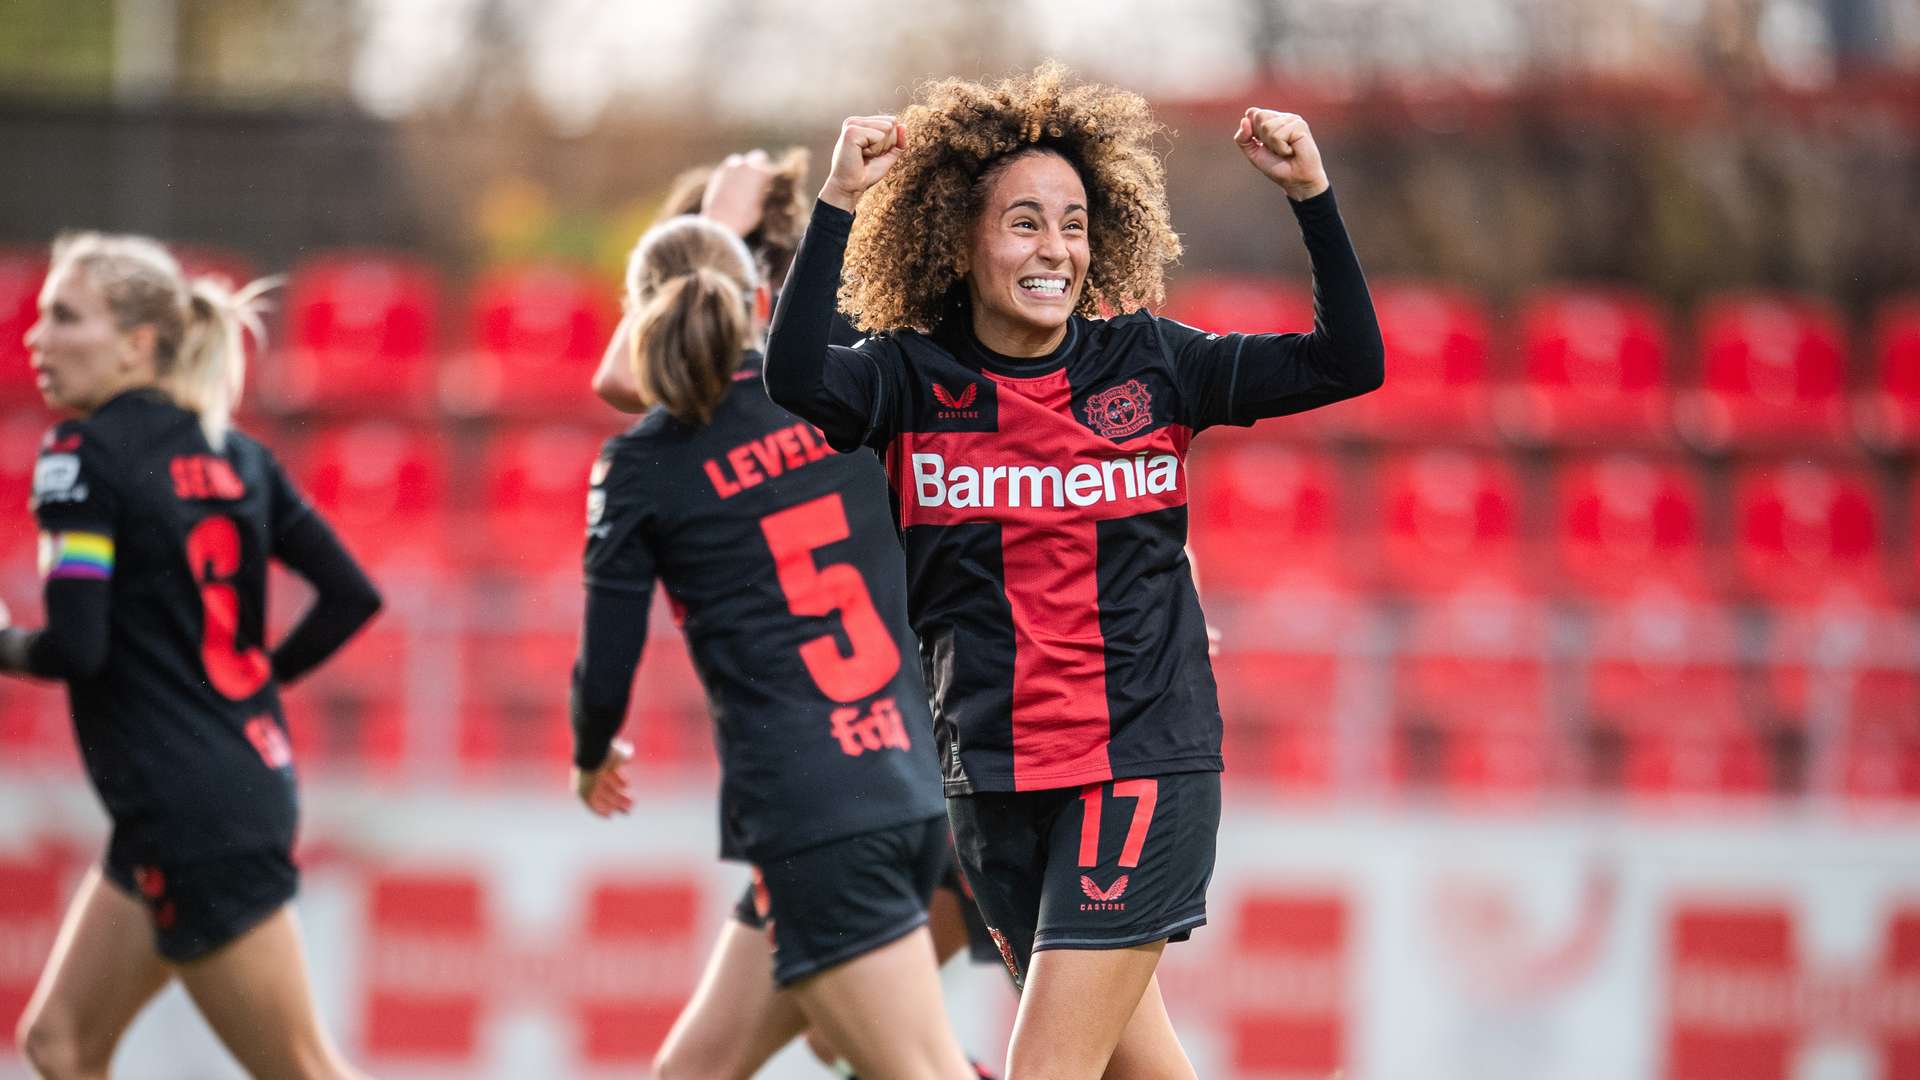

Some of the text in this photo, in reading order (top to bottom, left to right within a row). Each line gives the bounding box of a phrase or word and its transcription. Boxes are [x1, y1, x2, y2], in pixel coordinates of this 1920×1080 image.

[912, 451, 1178, 508] Barmenia
[760, 493, 901, 703] 5
[1079, 780, 1158, 868] 17
[1080, 903, 1126, 911] CASTORE
